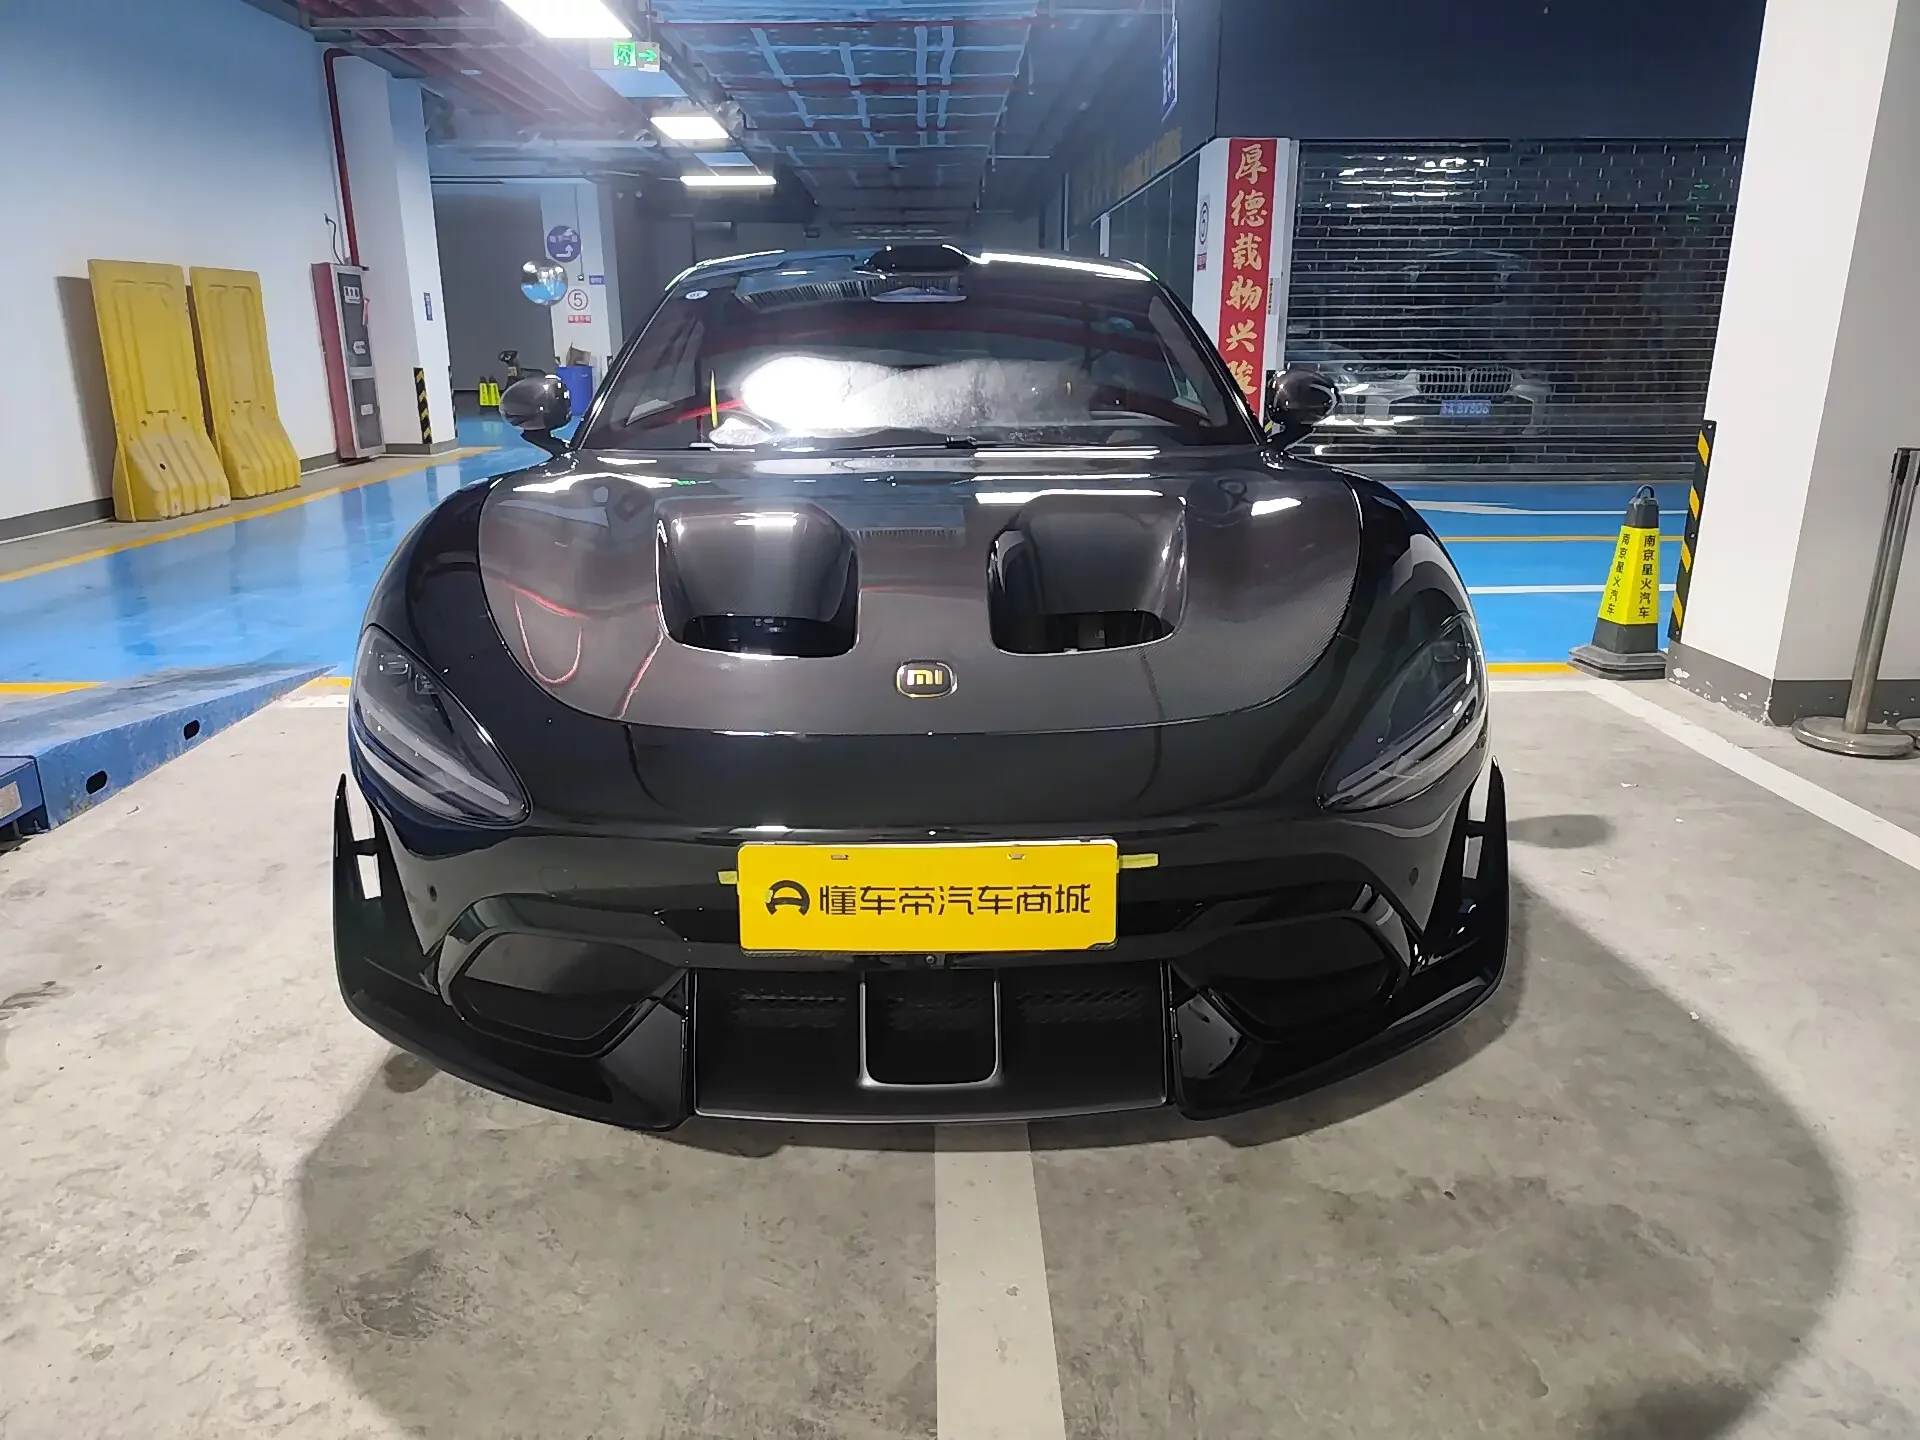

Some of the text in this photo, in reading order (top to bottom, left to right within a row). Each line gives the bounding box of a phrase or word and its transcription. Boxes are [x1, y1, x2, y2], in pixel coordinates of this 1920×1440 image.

[1606, 533, 1631, 615] 南京星火汽车
[1638, 534, 1657, 619] 南京星火汽车
[819, 884, 1092, 916] 懂车帝汽车商城
